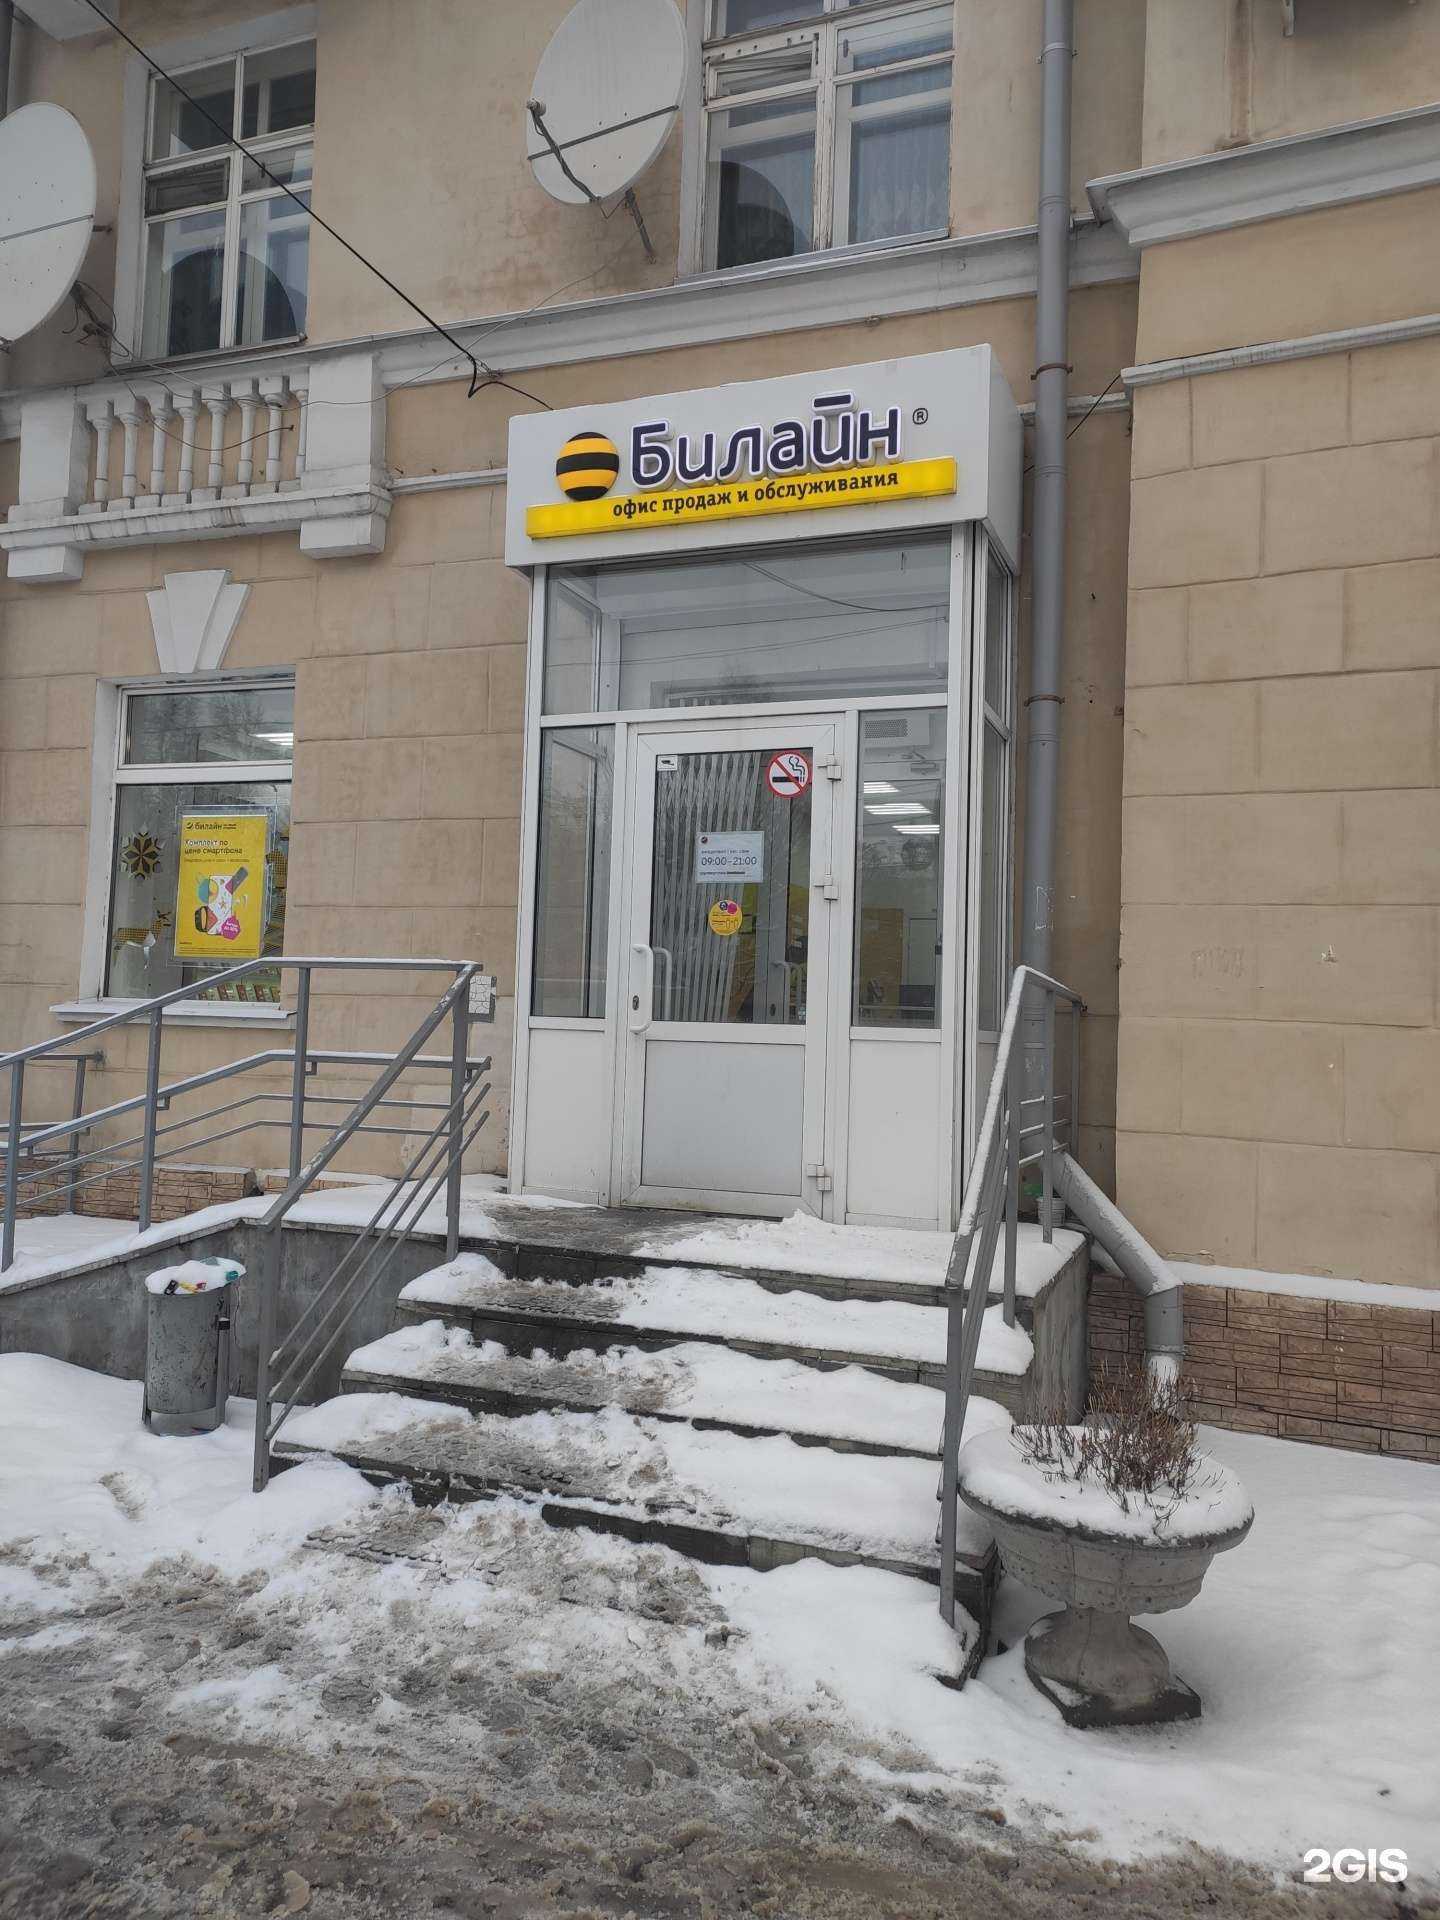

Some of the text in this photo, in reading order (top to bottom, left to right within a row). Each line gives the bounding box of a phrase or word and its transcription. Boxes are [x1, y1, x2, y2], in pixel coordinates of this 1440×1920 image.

[631, 389, 900, 488] Билайн
[613, 472, 899, 518] офис продаж и обслуживания
[194, 822, 223, 830] билайн
